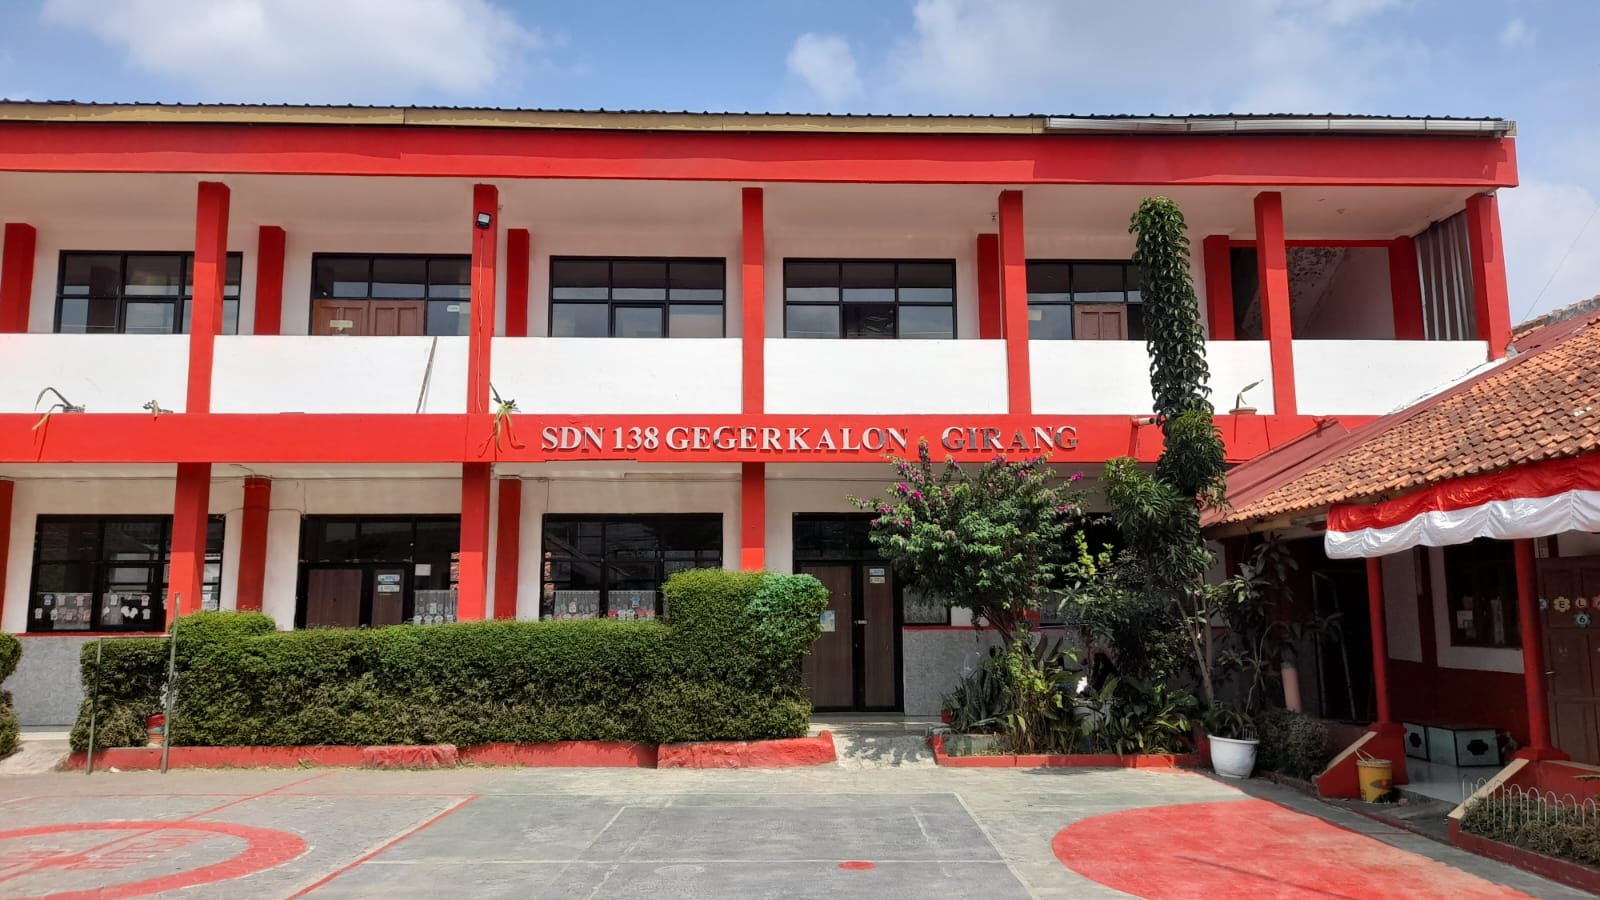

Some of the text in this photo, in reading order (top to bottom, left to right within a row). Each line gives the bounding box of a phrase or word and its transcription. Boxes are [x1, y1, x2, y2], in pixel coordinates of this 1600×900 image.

[541, 426, 1078, 452] SDN 138 GEGERKALON GIRANG
